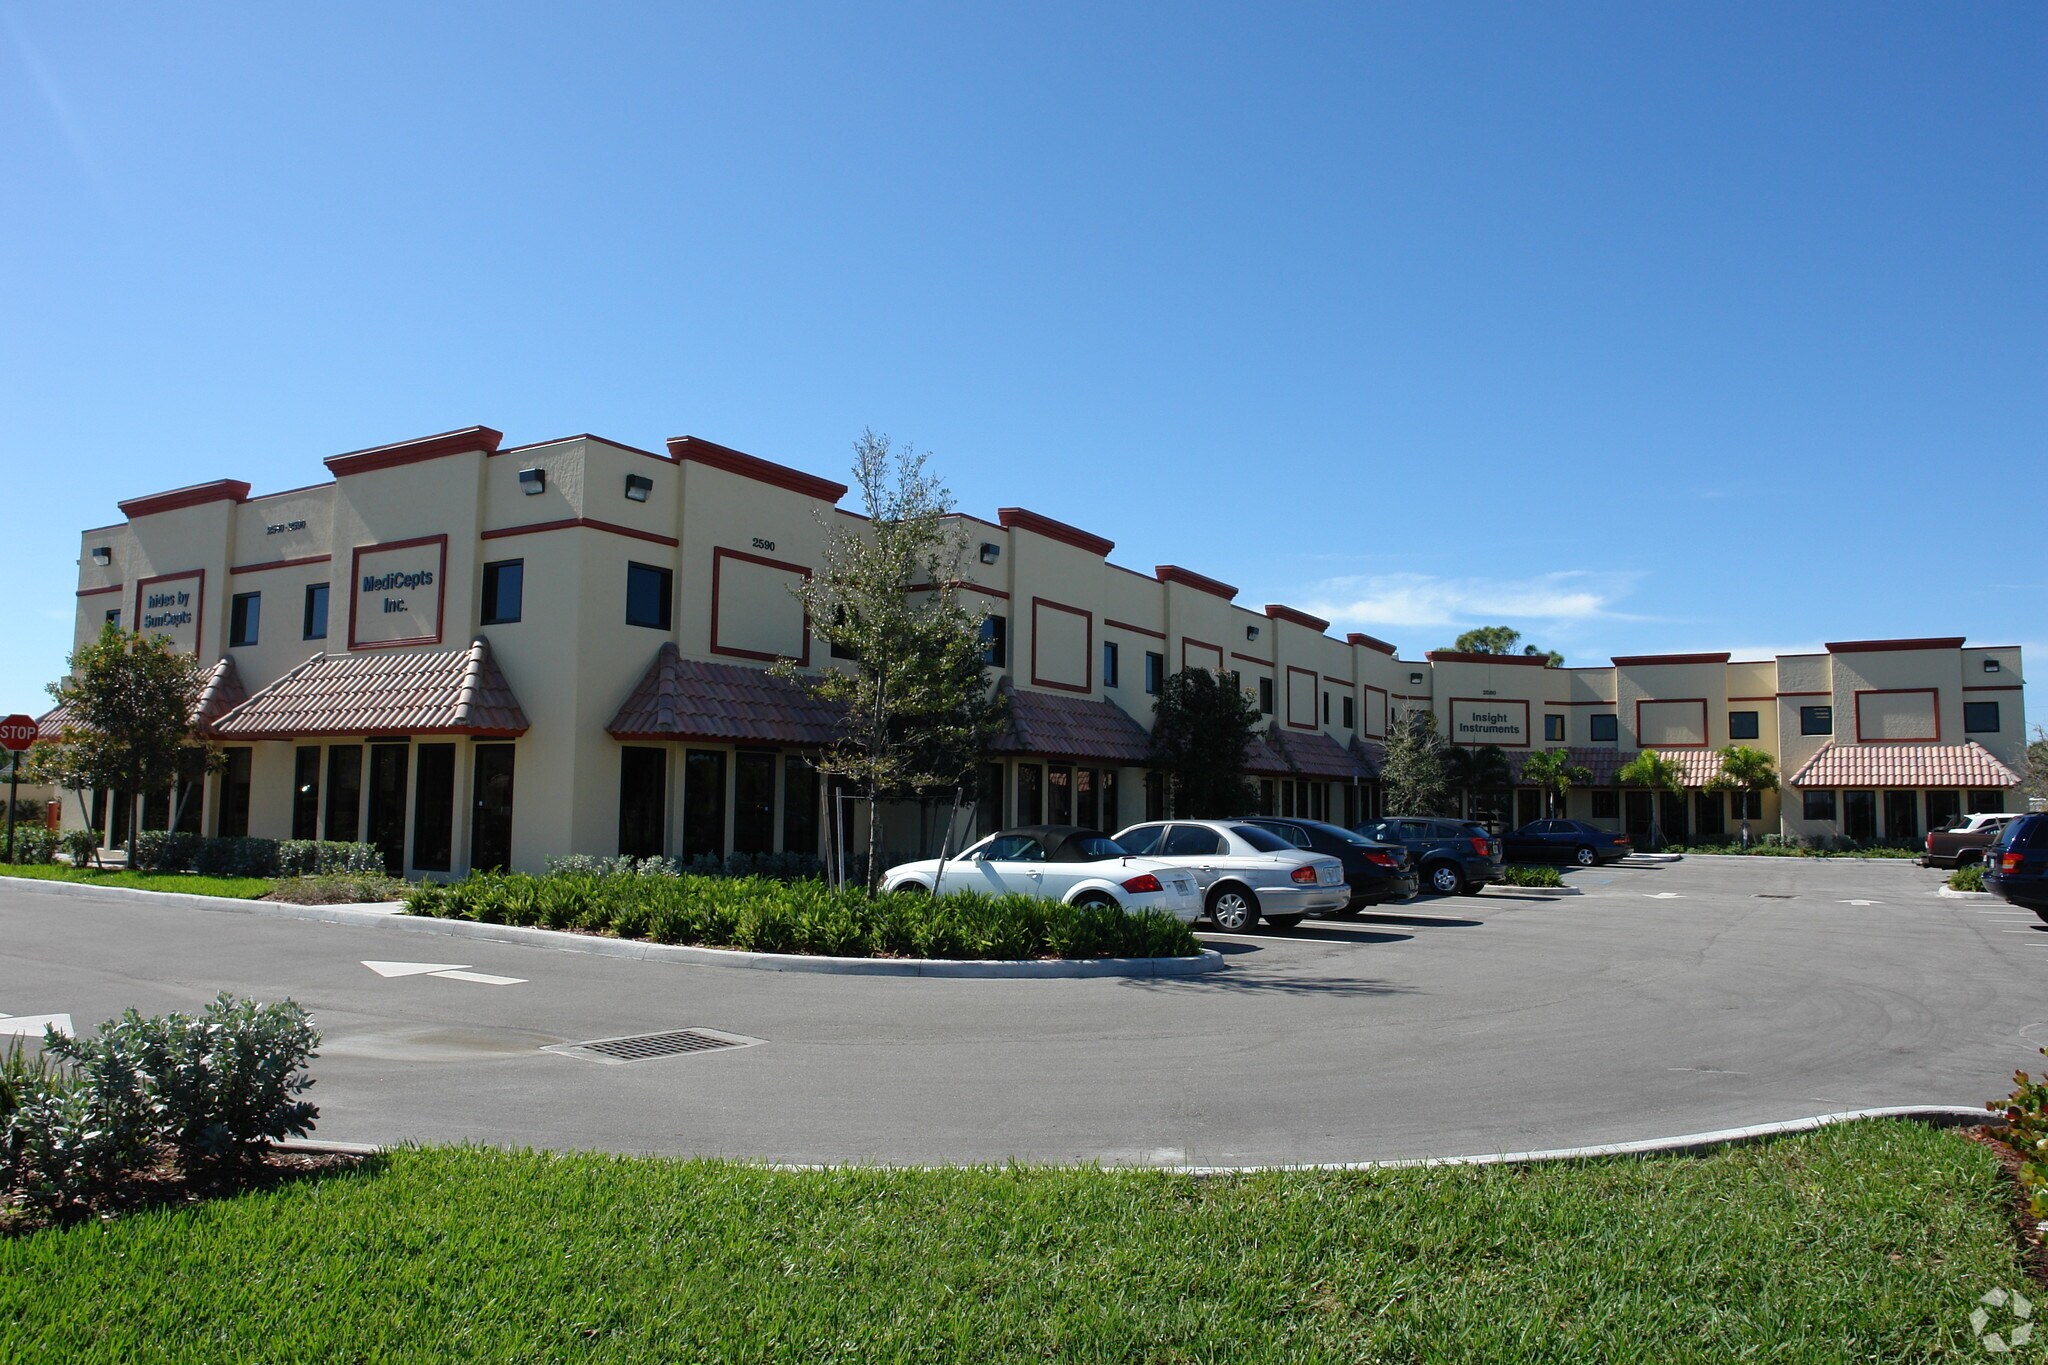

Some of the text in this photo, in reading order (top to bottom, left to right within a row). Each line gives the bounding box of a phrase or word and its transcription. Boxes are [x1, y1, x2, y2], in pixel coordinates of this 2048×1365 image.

[752, 537, 775, 551] 2590
[362, 570, 433, 592] MediCepts
[177, 591, 190, 607] by
[383, 597, 408, 613] Inc.
[144, 610, 192, 628] SunCepts
[1472, 712, 1508, 725] Insight
[0, 725, 36, 740] STOP
[1459, 723, 1520, 734] Instruments
